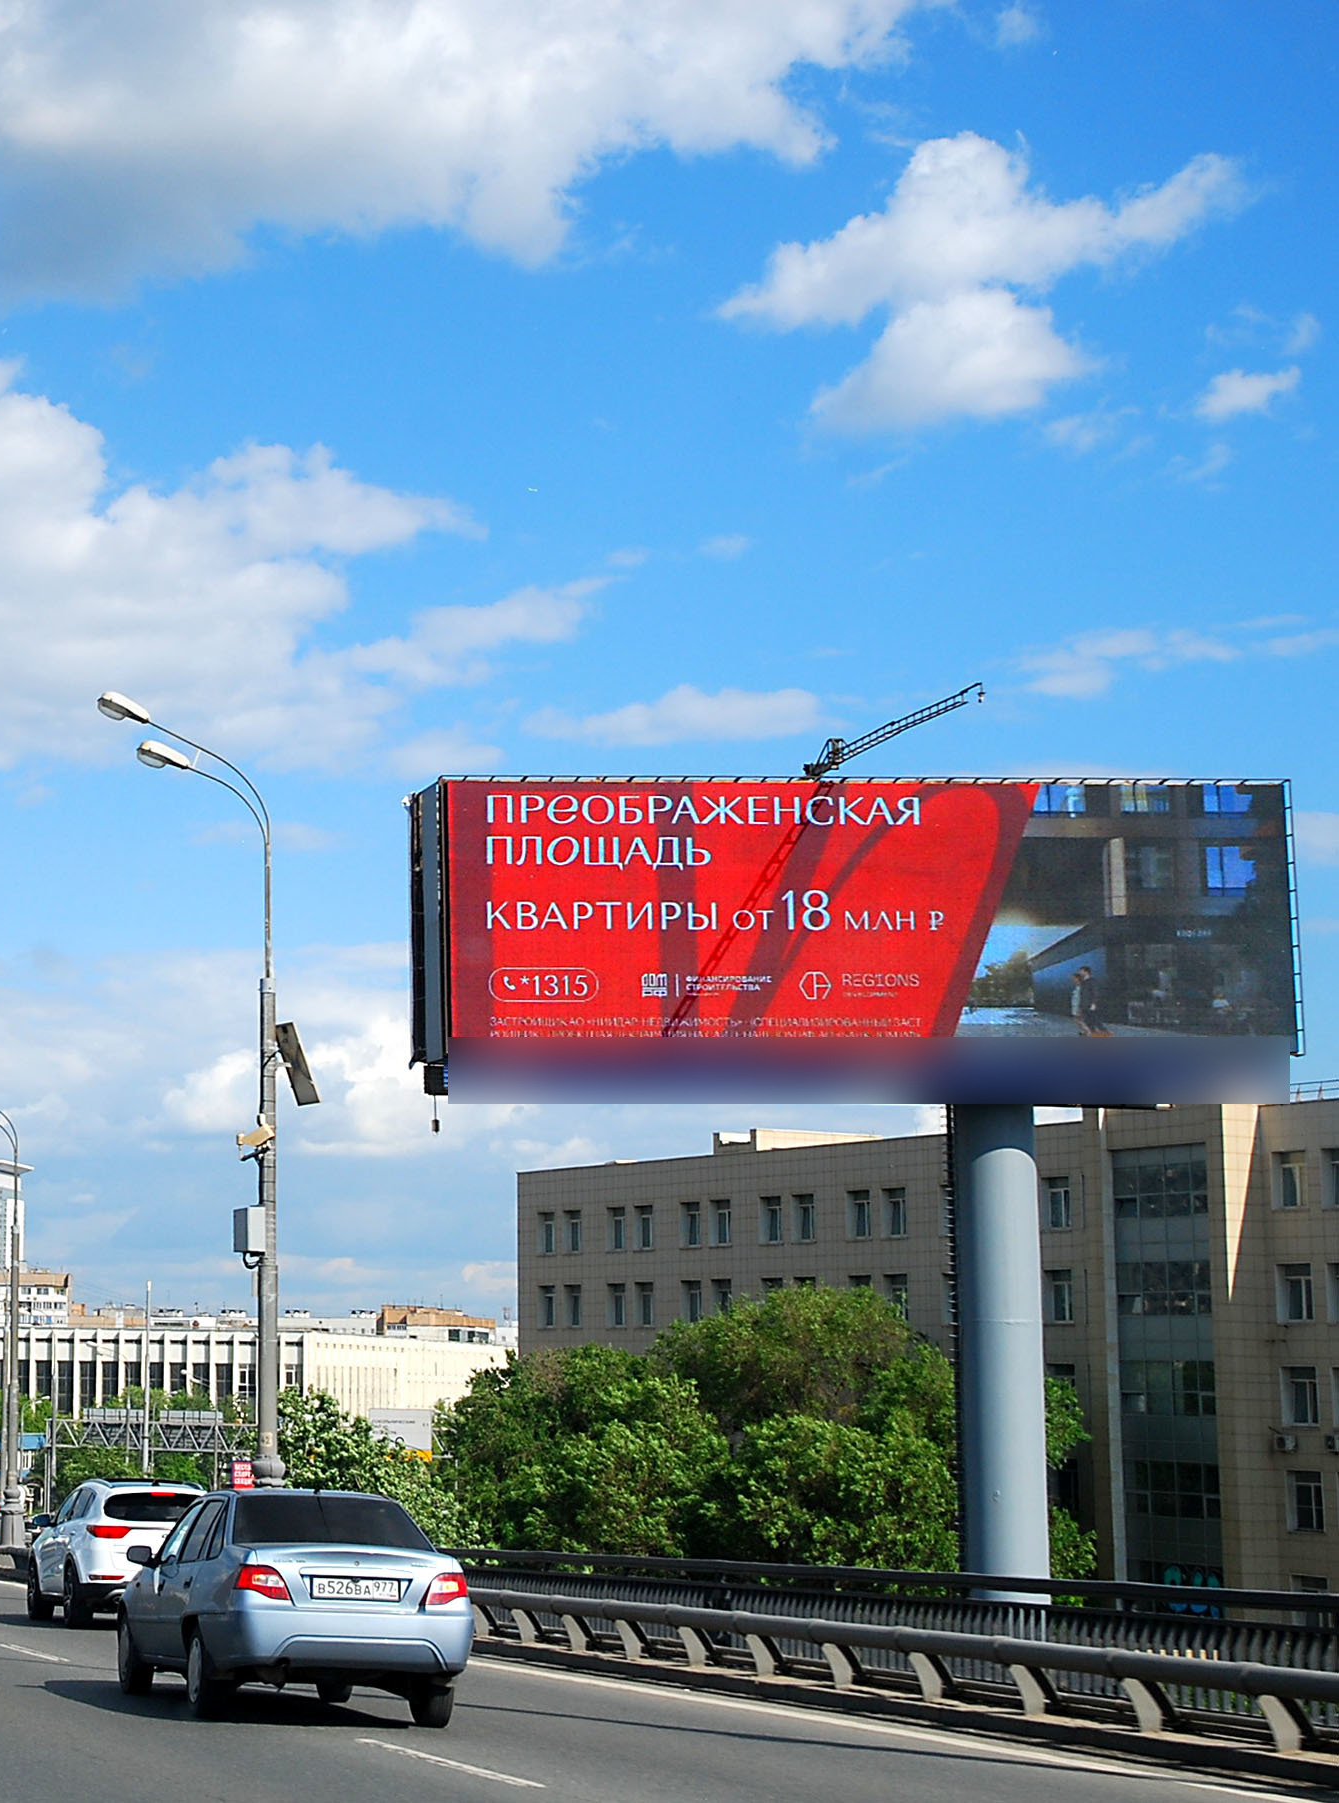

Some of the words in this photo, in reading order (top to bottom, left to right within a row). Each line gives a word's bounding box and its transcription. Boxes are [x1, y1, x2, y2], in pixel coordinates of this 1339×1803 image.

[486, 835, 712, 871] ПЛОЩАДЬ
[486, 900, 718, 931] КВАРТИРЫ
[781, 889, 831, 931] 18
[842, 973, 920, 987] REGIONS
[373, 1581, 395, 1592] 977
